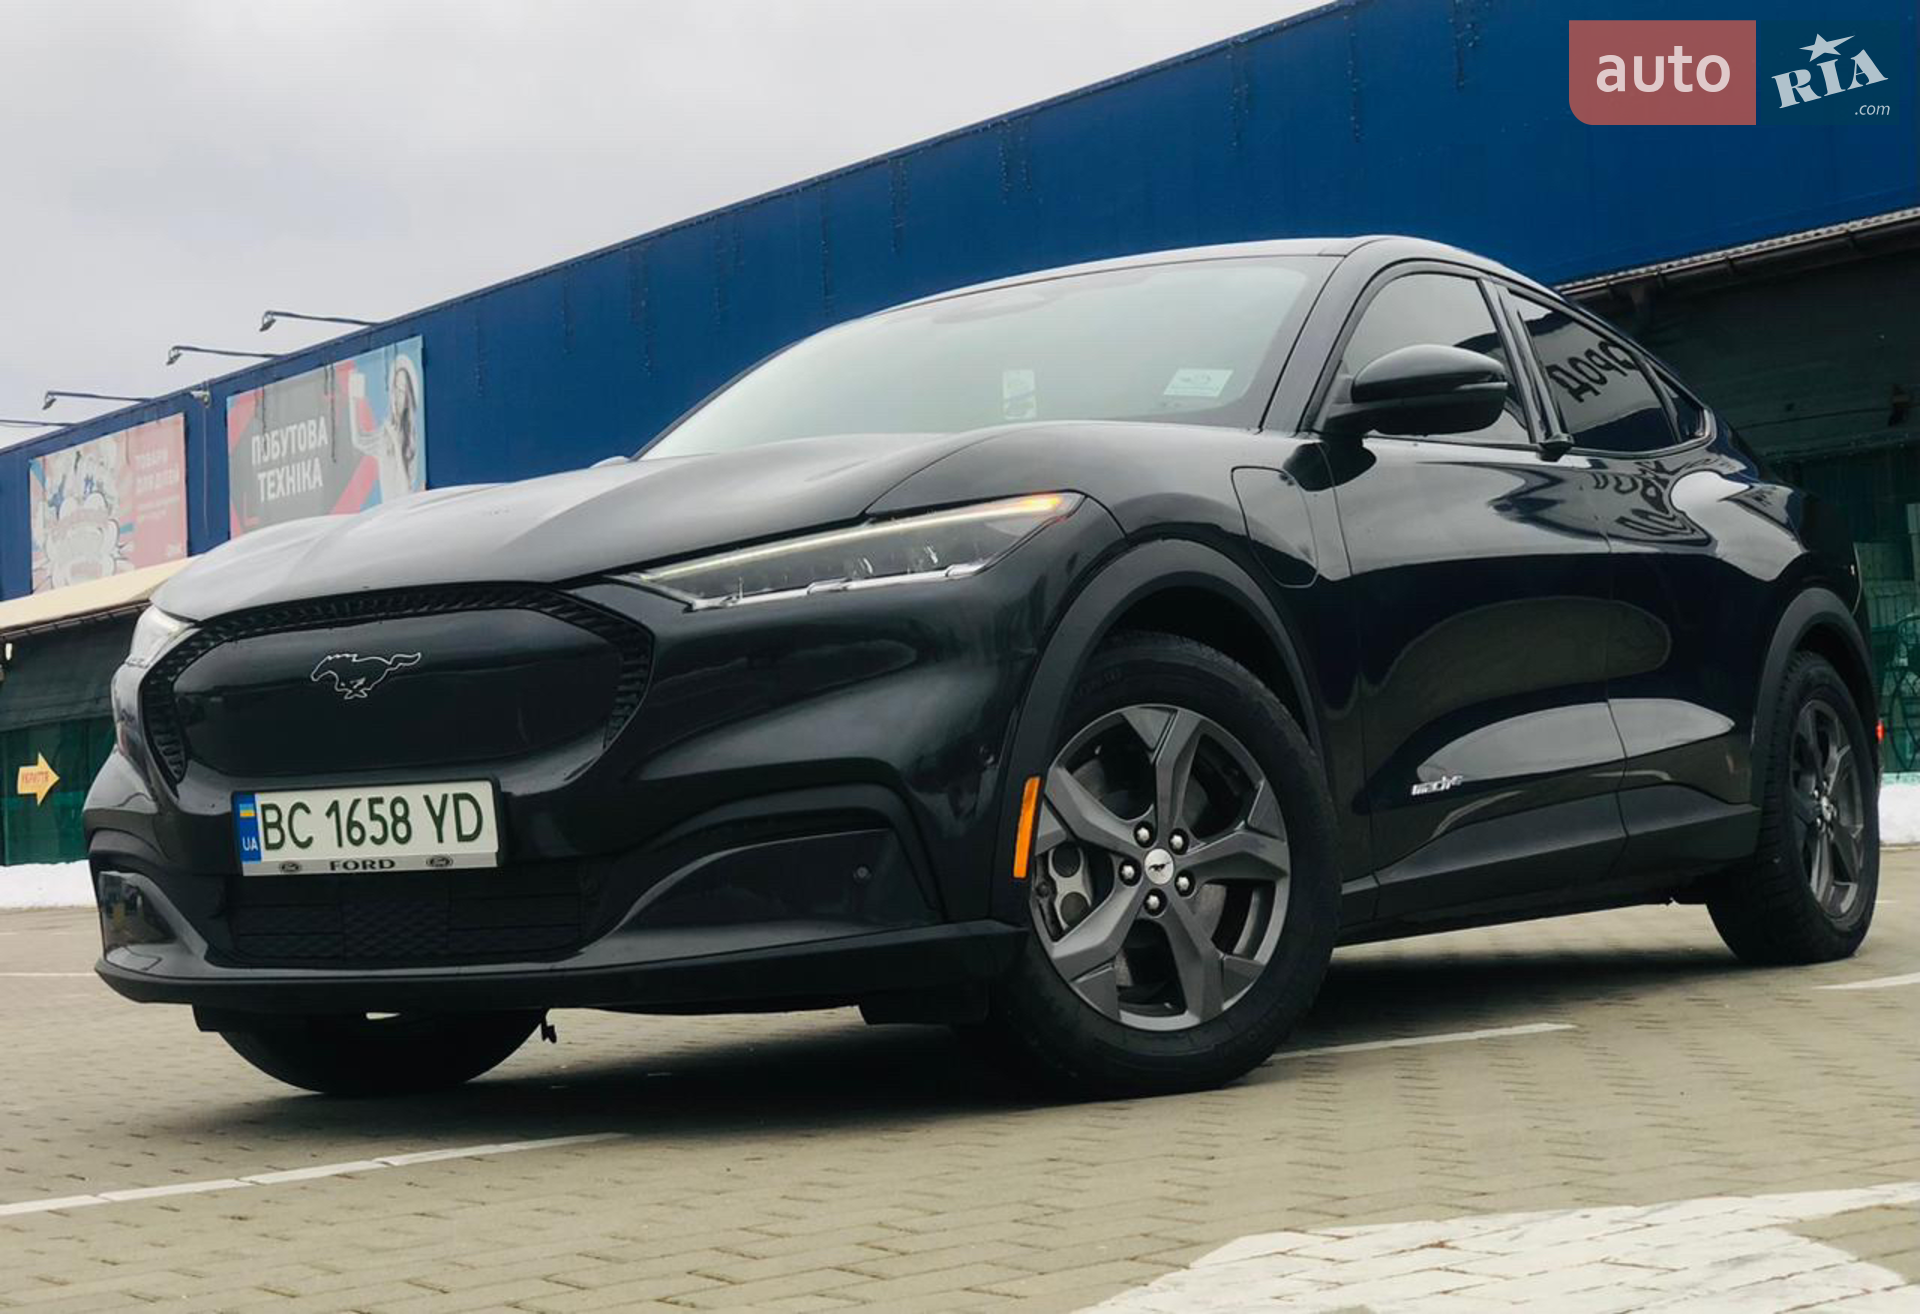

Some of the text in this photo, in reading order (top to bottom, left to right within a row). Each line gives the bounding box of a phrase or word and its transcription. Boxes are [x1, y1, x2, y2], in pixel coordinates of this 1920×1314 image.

[251, 416, 328, 466] ПОБУТОВА
[257, 457, 324, 503] ТЕХНІКА
[242, 837, 259, 852] UA
[261, 792, 484, 851] BC 1658 YD
[329, 858, 396, 872] FORD
